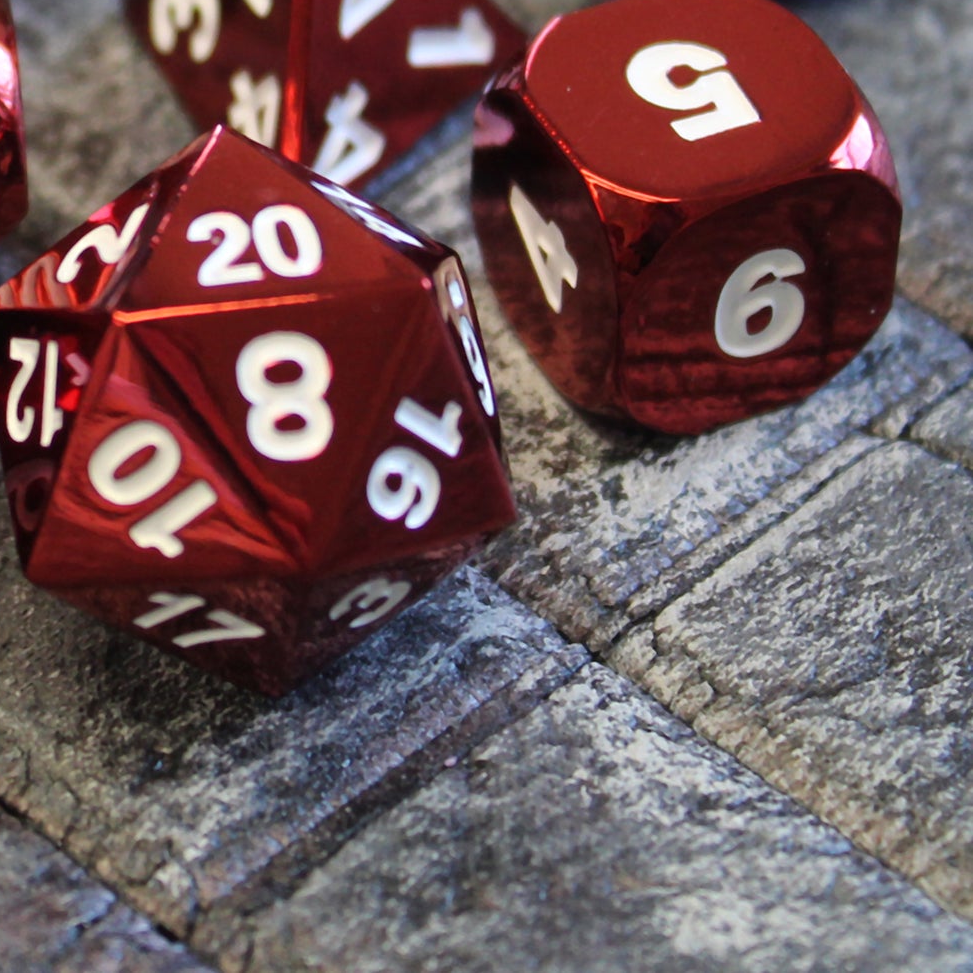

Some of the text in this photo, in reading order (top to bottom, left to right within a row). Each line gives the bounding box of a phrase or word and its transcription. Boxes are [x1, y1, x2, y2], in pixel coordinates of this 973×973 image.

[407, 7, 495, 68] 1
[627, 40, 761, 141] 5
[311, 79, 386, 187] 4
[57, 203, 149, 283] 2
[186, 205, 322, 287] 20
[509, 180, 578, 314] 4
[715, 248, 806, 358] 6
[6, 337, 63, 447] 12
[235, 331, 333, 461] 8
[87, 420, 218, 558] 10
[367, 397, 463, 529] 16
[133, 592, 266, 648] 17
[329, 578, 412, 628] 3
